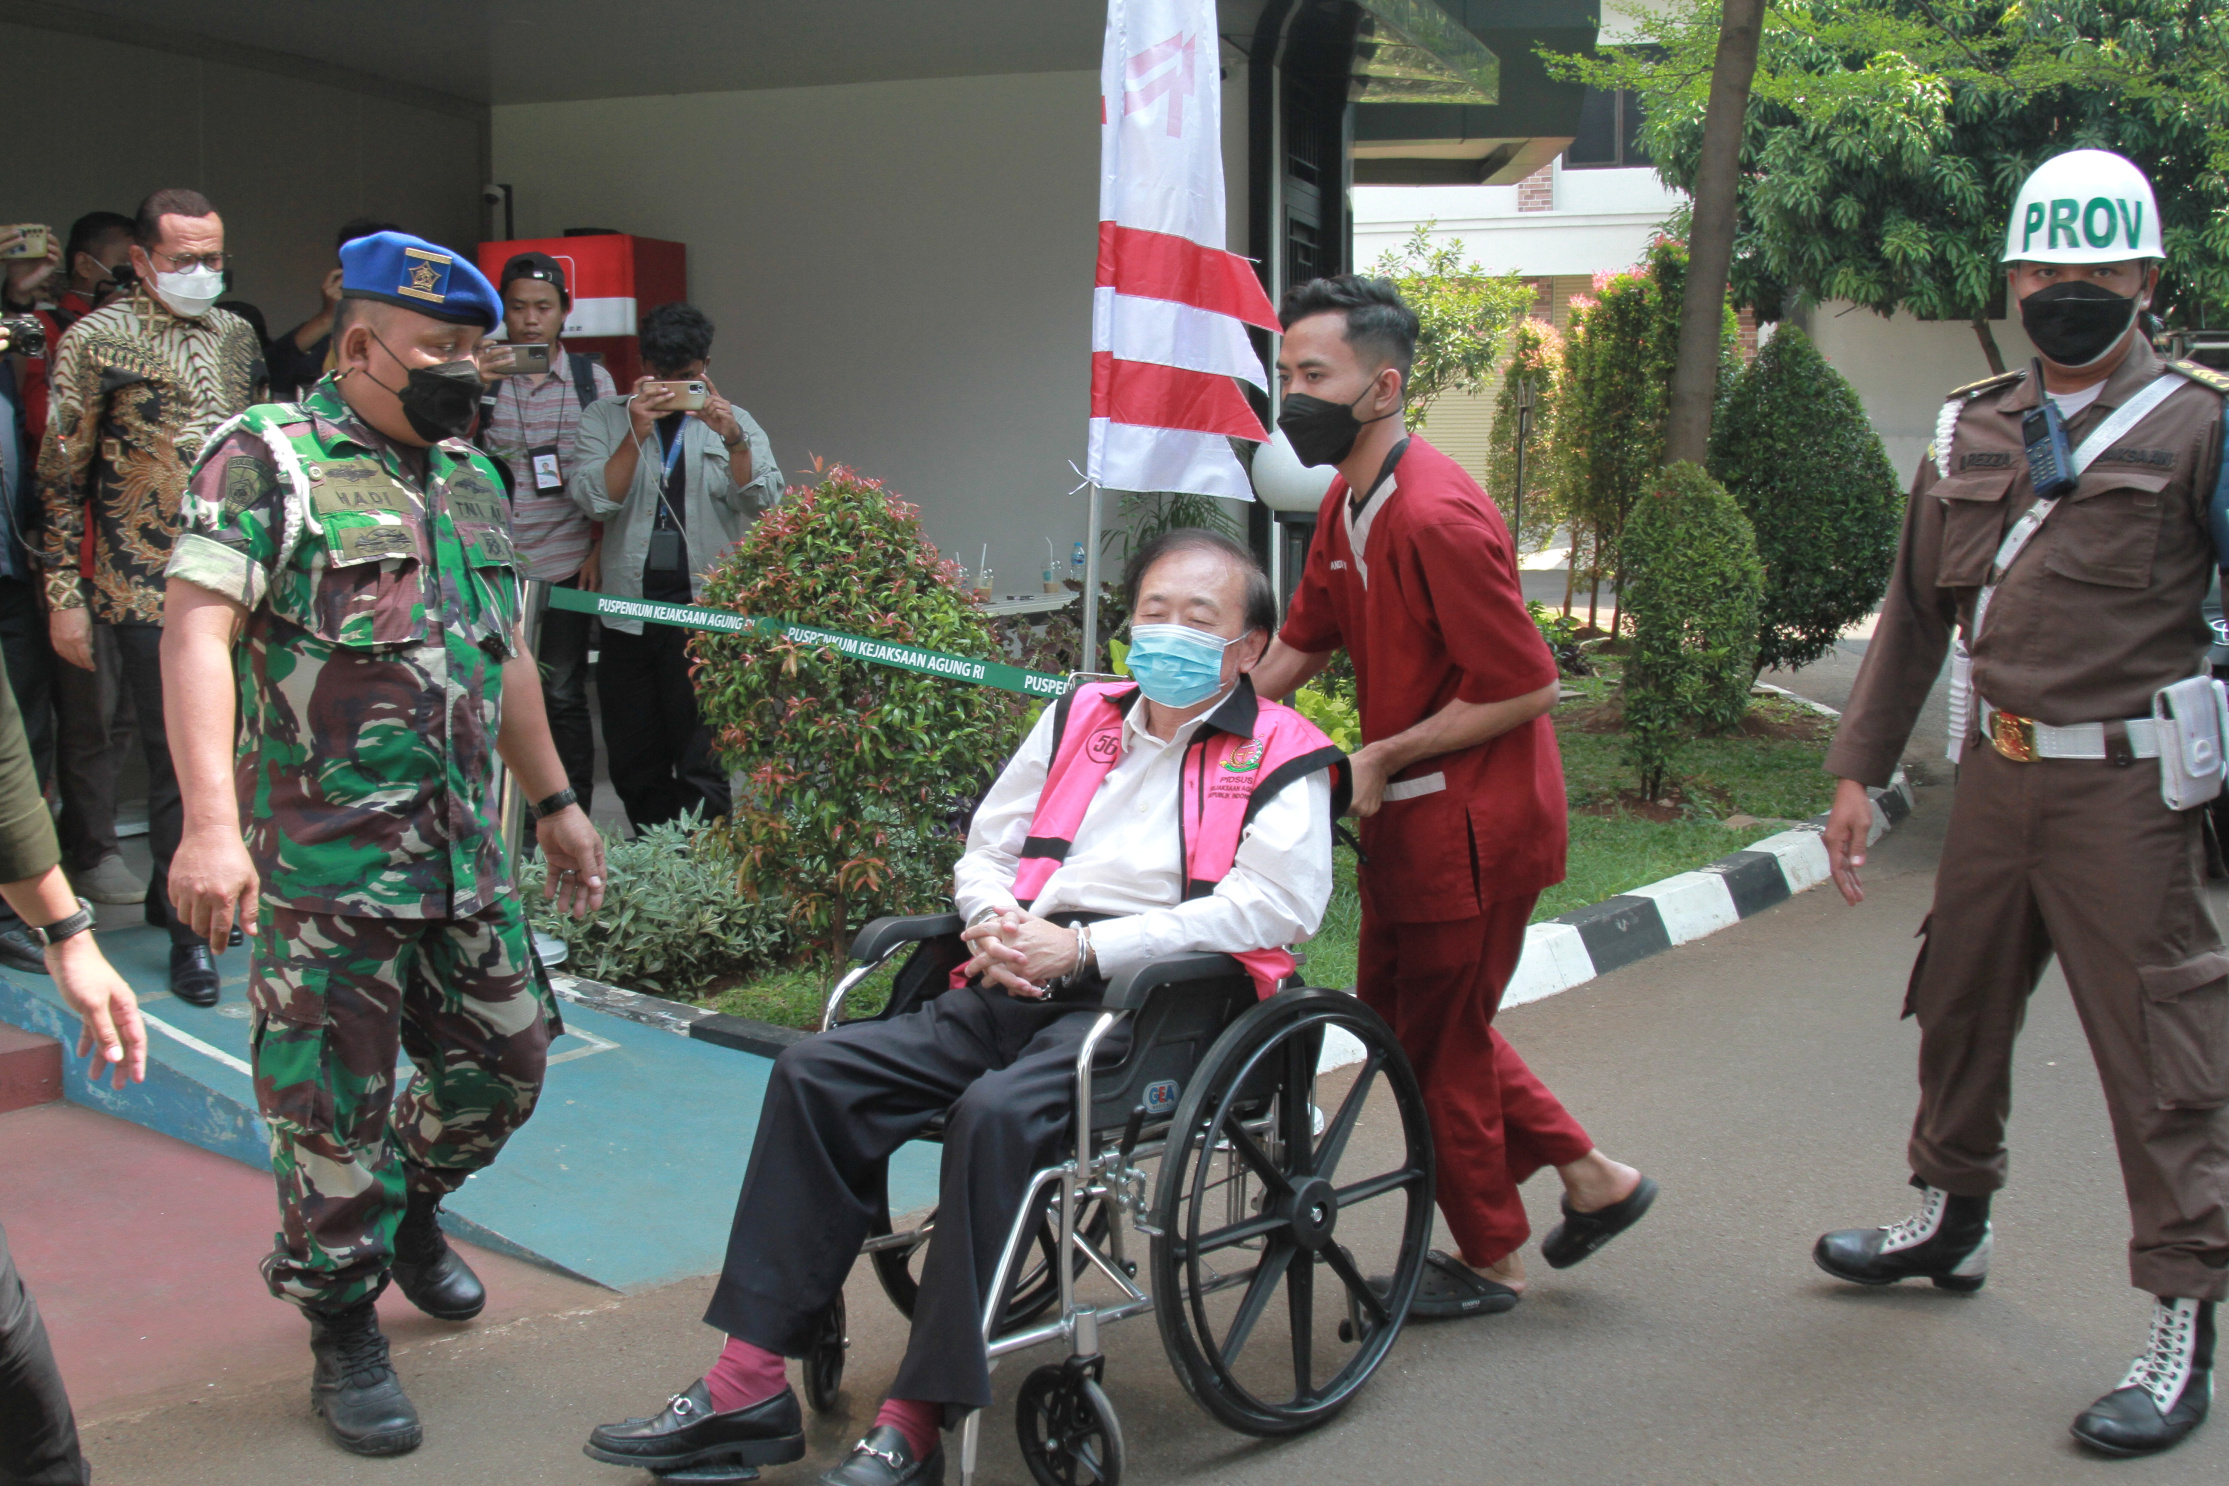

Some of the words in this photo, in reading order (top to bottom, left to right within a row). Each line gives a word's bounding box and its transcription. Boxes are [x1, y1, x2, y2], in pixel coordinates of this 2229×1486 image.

[2022, 197, 2142, 253] PROV
[335, 490, 393, 506] HADI
[455, 501, 485, 518] TNI
[598, 598, 652, 618] PUSPENKUM
[653, 605, 707, 626] KEJAKSAAN
[707, 613, 744, 630] AGUNG
[858, 641, 926, 668] KEJAKSAAN
[927, 654, 972, 676] AGUNG
[972, 663, 986, 680] RI
[1093, 735, 1120, 755] 56
[1220, 776, 1253, 784] PIDSUS
[1150, 1085, 1175, 1104] GEA
